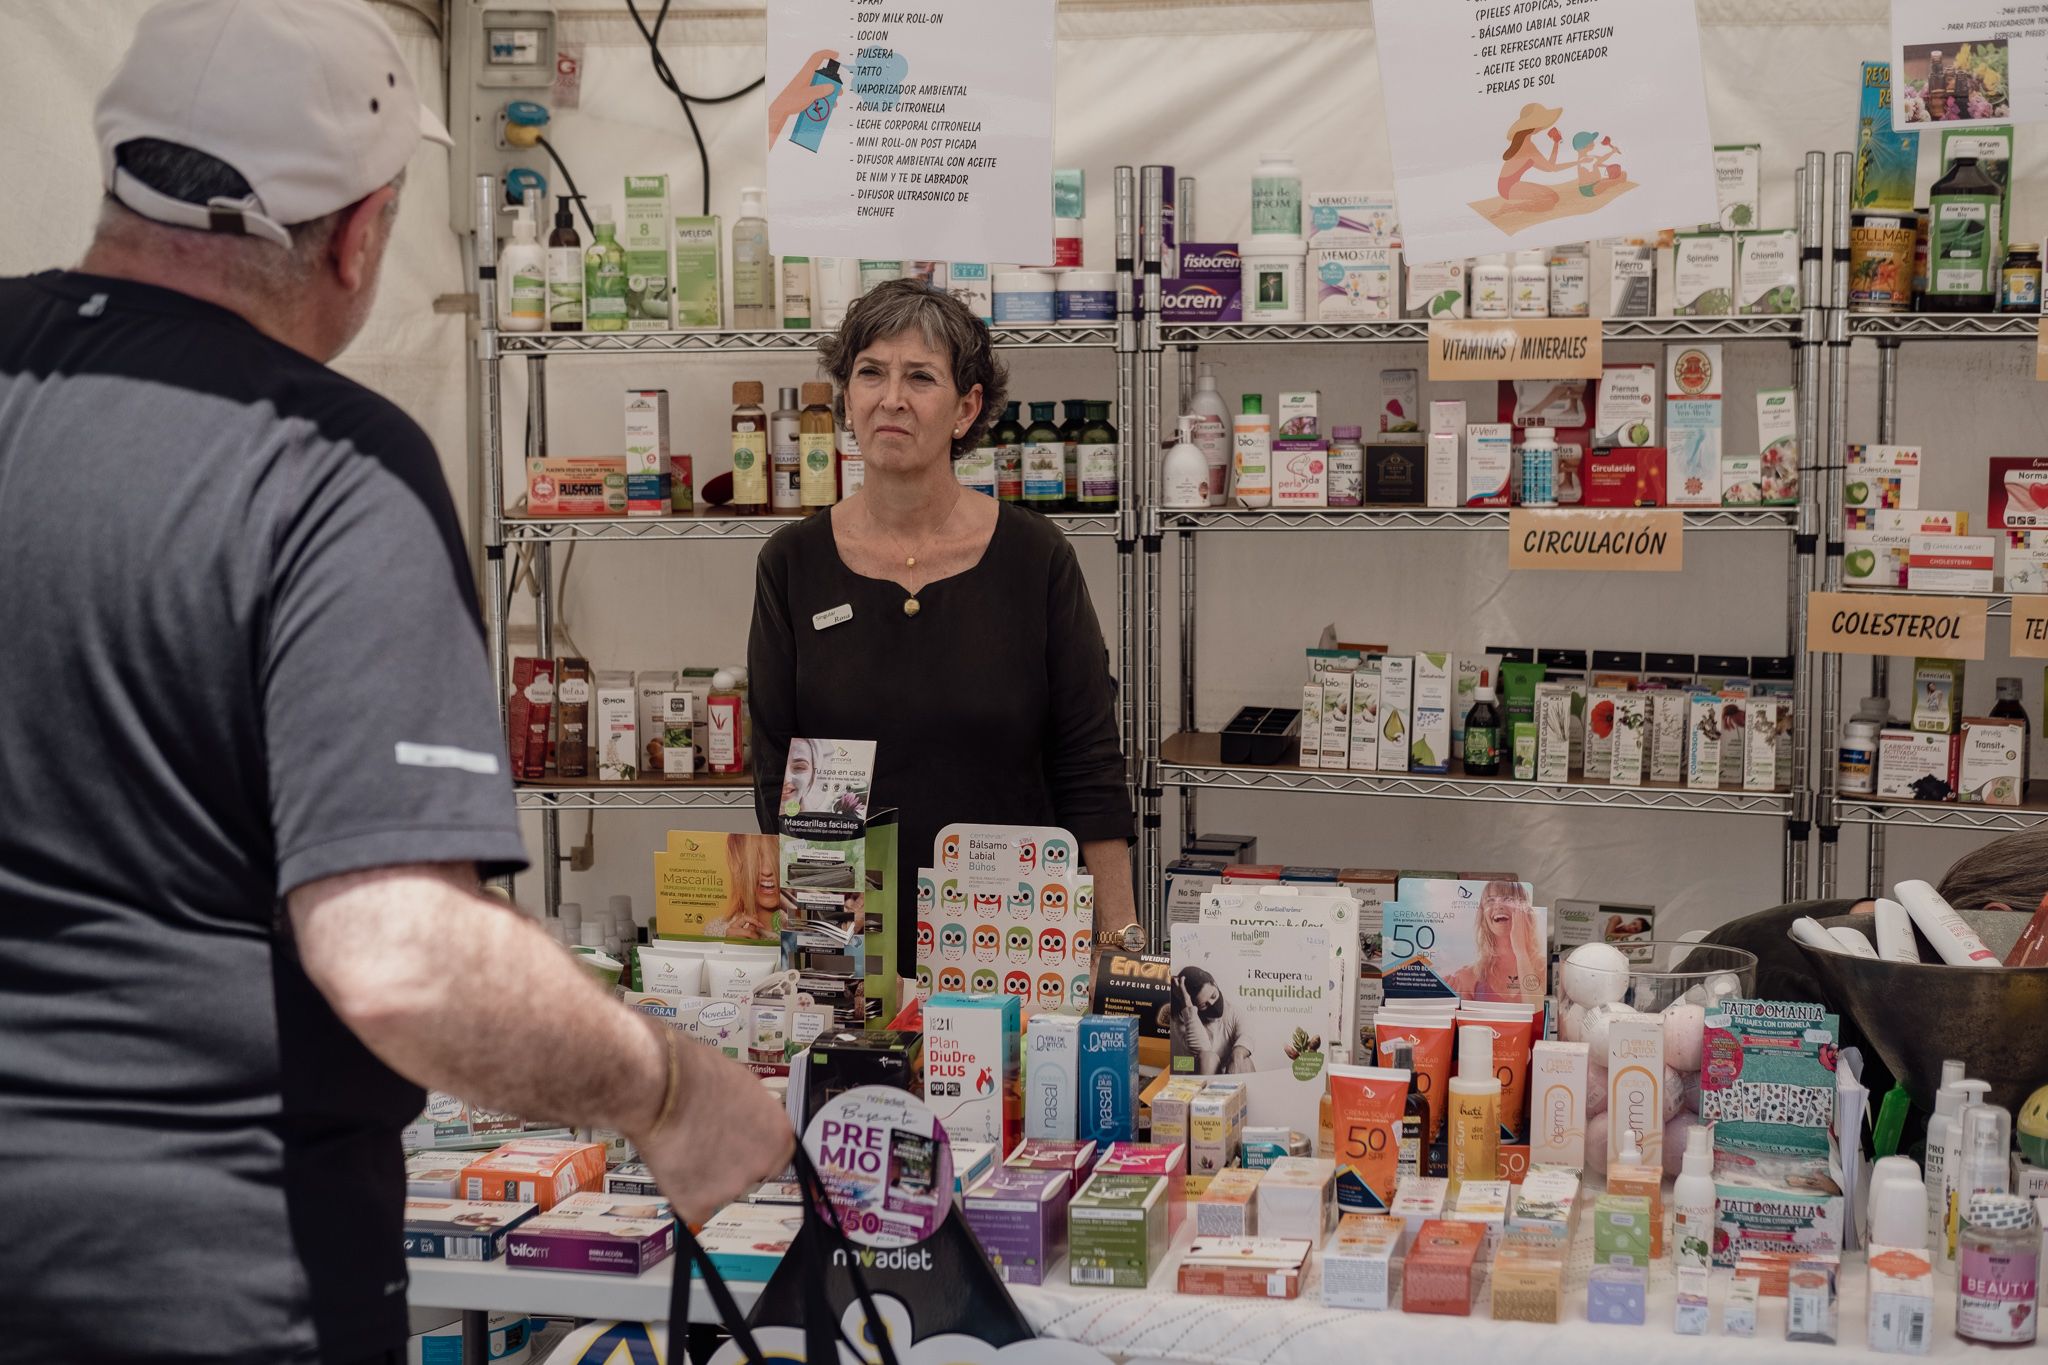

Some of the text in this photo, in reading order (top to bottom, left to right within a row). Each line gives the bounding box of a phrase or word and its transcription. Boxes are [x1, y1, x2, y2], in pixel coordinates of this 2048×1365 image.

[857, 13, 943, 24] BODY MILK ROLL-ON
[1475, 6, 1511, 21] (PIELES
[1479, 11, 1590, 39] BÁLSAMO LABIAL SOLAR
[857, 31, 888, 41] LOCION
[1481, 26, 1614, 58] GEL REFRESCANTE AFTERSUN
[857, 48, 893, 59] PULSERA
[1483, 46, 1608, 76] ACEITE SECO BRONCEADOR
[857, 66, 882, 76] TATTO
[857, 84, 967, 96] VAPORIZADOR AMBIENTAL
[1486, 73, 1555, 95] PERLAS DE SOL
[856, 102, 945, 113] AGUA DE CITRONELLA
[856, 120, 981, 132] LECHE CORPORAL CITRONELLA
[856, 137, 977, 150] MINI ROLL-ON POST PICADA
[857, 155, 997, 168] DIFUSOR AMBIENTAL CON ACEITE
[856, 172, 968, 185] DE NIM Y TE DE LABRADOR
[857, 190, 968, 202] DIFUSOR ULTRASONICO DE
[1277, 188, 1289, 197] de
[857, 206, 895, 217] ENCHUFE
[679, 229, 713, 238] WELEDA
[1321, 251, 1386, 260] MEMOSTAR
[1686, 253, 1720, 264] Spirulina
[1750, 251, 1784, 261] Chlorella
[1615, 260, 1643, 272] Hierro
[1442, 336, 1588, 362] VITAMINAS / MINERALES
[1611, 385, 1639, 394] Piernas
[1470, 426, 1498, 437] V-Vein
[1336, 462, 1352, 470] Vitex
[1591, 463, 1636, 473] Circulación
[1301, 475, 1319, 485] vida
[1524, 527, 1667, 555] CIRCULACIÓN
[1832, 611, 1960, 640] COLESTEROL
[1975, 740, 2005, 749] Transit+
[784, 818, 858, 829] Mascarillas faciales
[969, 840, 1008, 850] Bálsamo
[969, 851, 995, 861] Labial
[969, 862, 996, 871] Búhos
[663, 874, 723, 886] Mascarilla
[1178, 889, 1188, 897] No
[1393, 910, 1455, 920] CREMA SOLAR
[1231, 929, 1270, 942] HerbalGem
[1391, 924, 1435, 959] 50
[1141, 955, 1170, 963] WEIDER
[1254, 969, 1302, 982] Recupera
[1110, 980, 1151, 989] CAFFEINE
[651, 987, 682, 995] Mascarilla
[1238, 985, 1322, 1001] tranquilidad
[702, 1006, 736, 1018] Novedad
[1247, 1005, 1257, 1013] de
[1722, 1003, 1824, 1020] TATTOOMANIA
[690, 1022, 698, 1031] el
[1735, 1018, 1762, 1027] TATUAJES
[930, 1036, 959, 1049] Plan
[1115, 1033, 1124, 1041] DE
[930, 1051, 976, 1063] DiuDre
[749, 1065, 776, 1074] Tránsito
[930, 1065, 966, 1077] PLUS
[1041, 1084, 1058, 1128] nasal
[1096, 1084, 1112, 1129] nasal
[1554, 1100, 1565, 1144] dermo
[822, 1120, 884, 1150] PRE
[1456, 1120, 1465, 1145] Sun
[1346, 1126, 1386, 1158] 50
[819, 1145, 880, 1173] MIO
[1723, 1200, 1816, 1217] TATTOOMANIA
[510, 1243, 549, 1258] biform
[1968, 1278, 2029, 1292] BEAUTY
